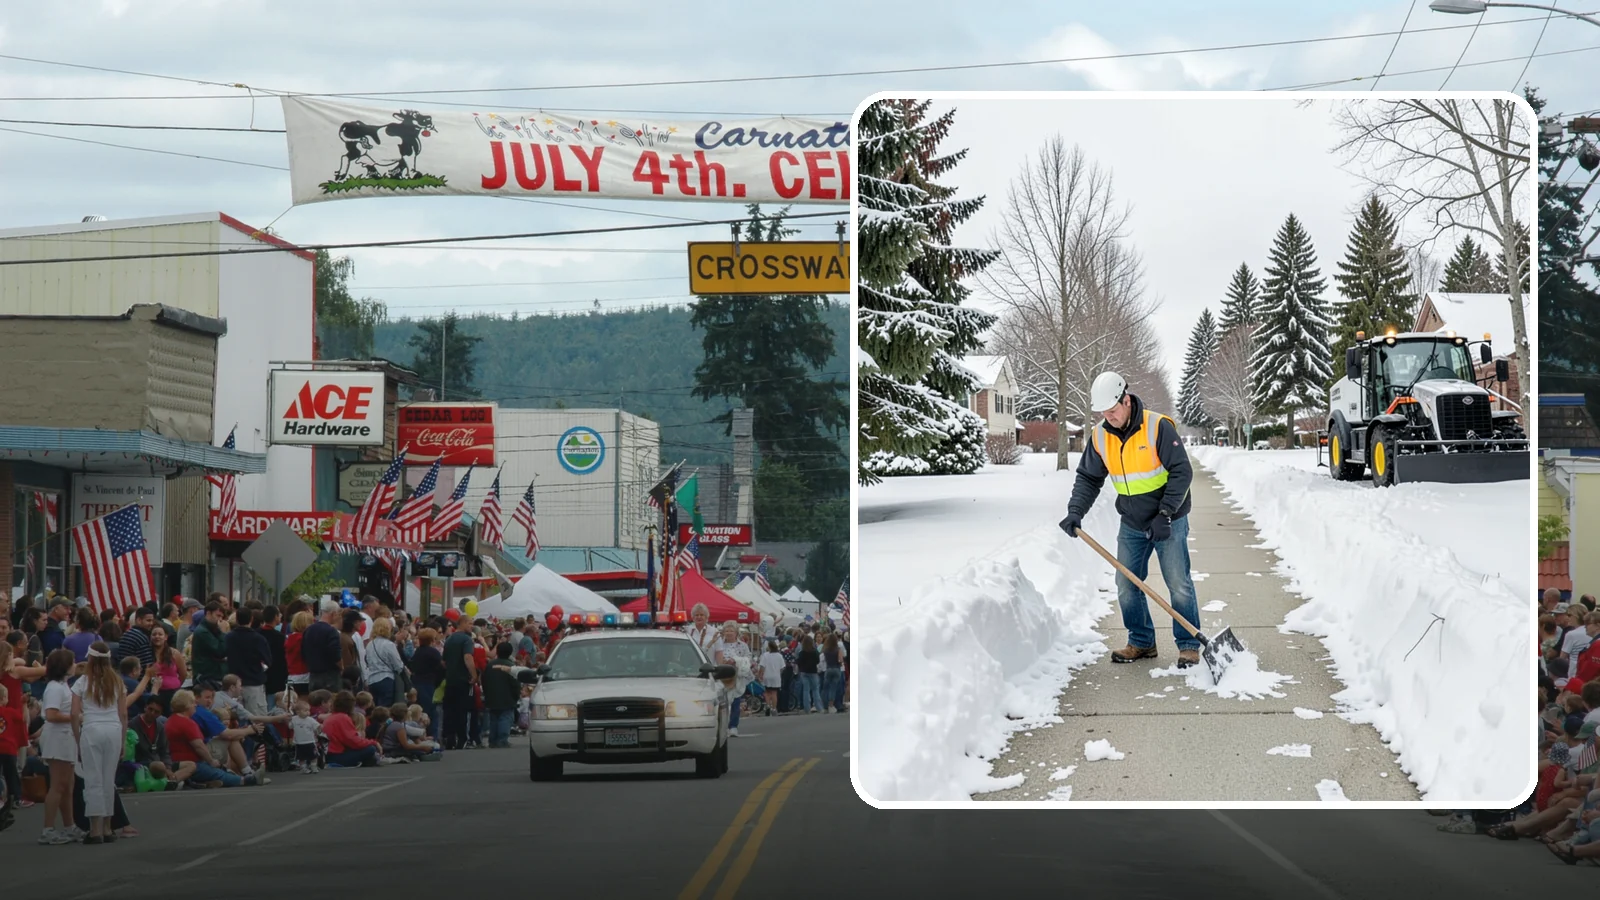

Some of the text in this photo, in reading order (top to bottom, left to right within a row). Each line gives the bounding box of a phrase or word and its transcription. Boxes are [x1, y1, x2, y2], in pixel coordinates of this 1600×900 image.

[481, 140, 605, 192] JULY
[632, 150, 747, 198] 4th.
[697, 254, 850, 280] CROSSWA
[282, 380, 374, 420] ACE
[406, 409, 485, 422] CEDAR LOG
[283, 421, 371, 437] Hardware
[416, 428, 477, 447] Coca-Cola
[353, 467, 385, 479] Simpl
[95, 485, 124, 495] Vincent
[126, 486, 136, 495] de
[137, 486, 155, 495] Paul
[81, 504, 154, 522] THRT
[688, 527, 741, 535] CRNATION
[699, 535, 730, 543] GLASS
